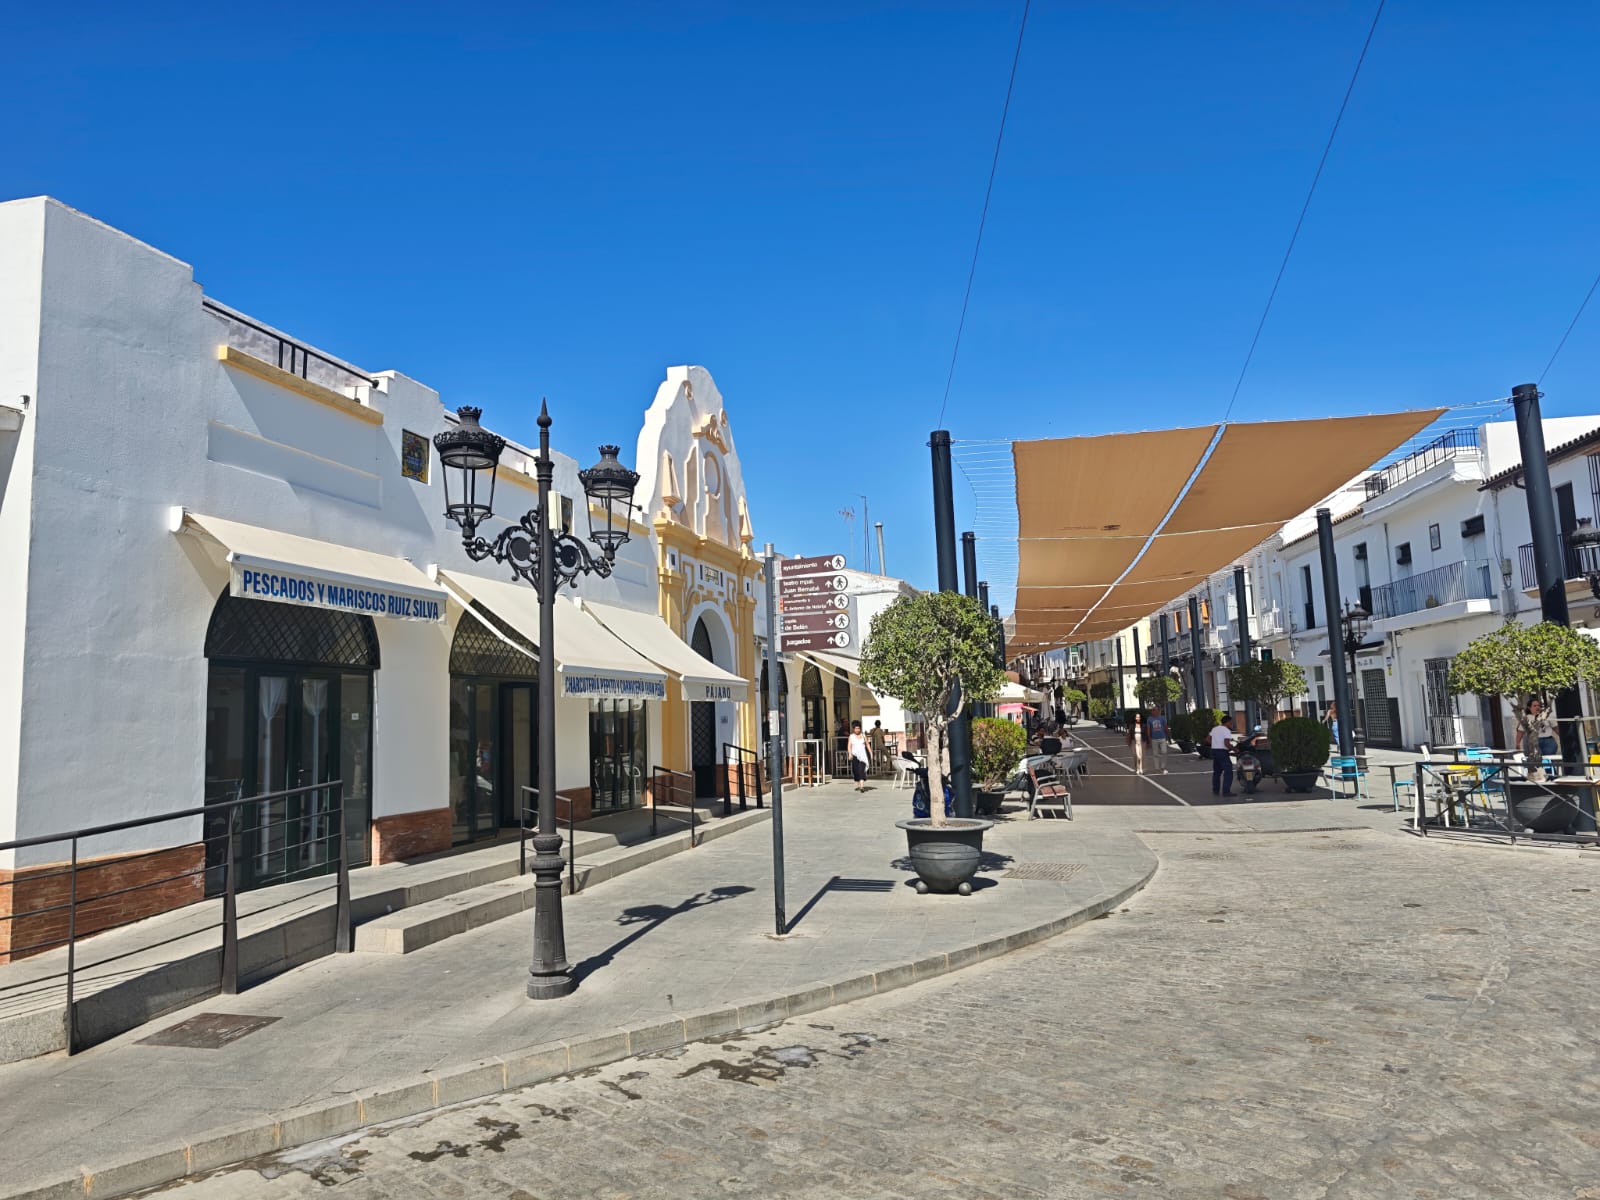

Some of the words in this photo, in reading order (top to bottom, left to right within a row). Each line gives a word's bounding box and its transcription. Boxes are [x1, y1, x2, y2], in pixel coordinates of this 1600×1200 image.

[243, 570, 315, 602] PESCADOS
[317, 583, 326, 605] Y
[327, 586, 386, 612] MARISCOS
[388, 596, 411, 616] RUIZ
[413, 600, 439, 620] SILVA
[706, 683, 730, 698] PÁJARO
